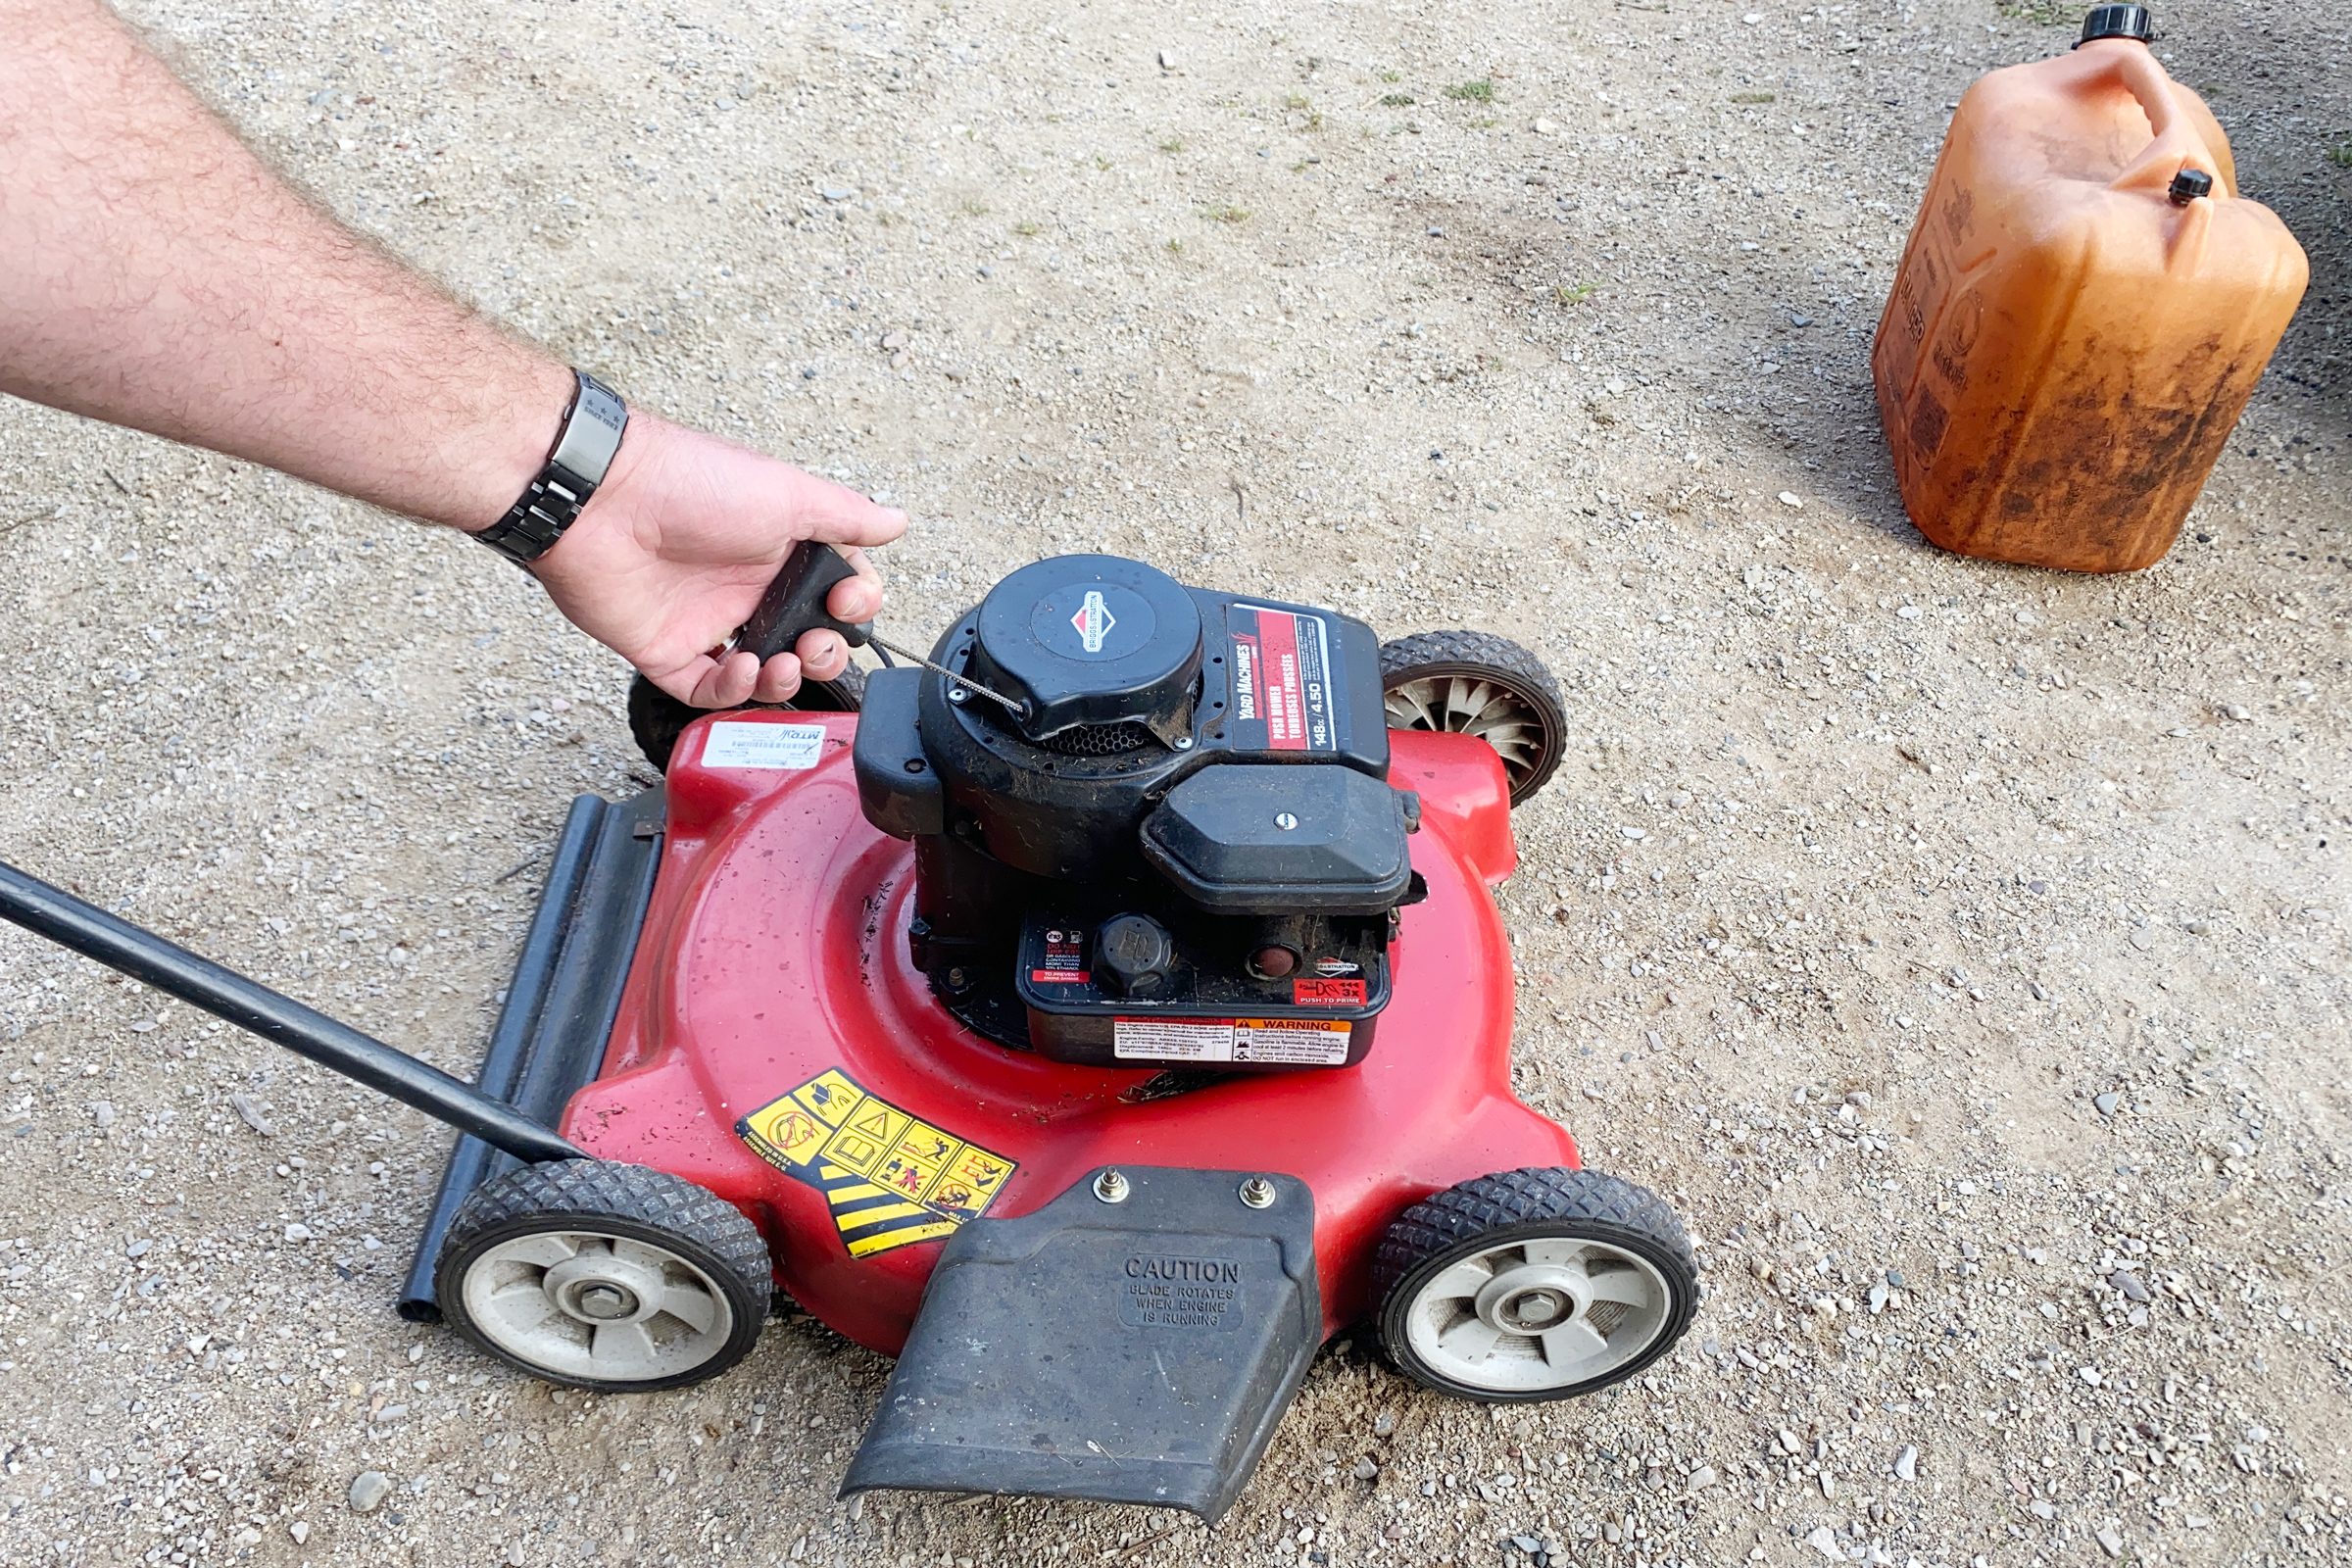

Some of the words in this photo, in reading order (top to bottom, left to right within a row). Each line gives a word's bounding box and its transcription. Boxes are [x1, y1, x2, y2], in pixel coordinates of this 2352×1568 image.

[1237, 644, 1253, 695] MACHINES
[1281, 654, 1297, 692] POUSSÉES
[1239, 696, 1255, 720] YARD
[1270, 686, 1283, 716] MOWER
[1309, 684, 1323, 713] 4.50
[1272, 716, 1285, 739] PUSH
[1285, 693, 1301, 739] TONDEUSES
[1263, 1020, 1331, 1031] WARNING
[747, 1131, 772, 1153] ASSEMBLED
[1126, 1258, 1239, 1284] CAUTION
[1130, 1285, 1171, 1296] BLADE
[1177, 1287, 1234, 1299] ROTATES
[1136, 1298, 1173, 1310] WHEN
[1179, 1300, 1226, 1313] ENGINE
[1144, 1312, 1155, 1323] IS
[1163, 1313, 1219, 1326] RUNNING
